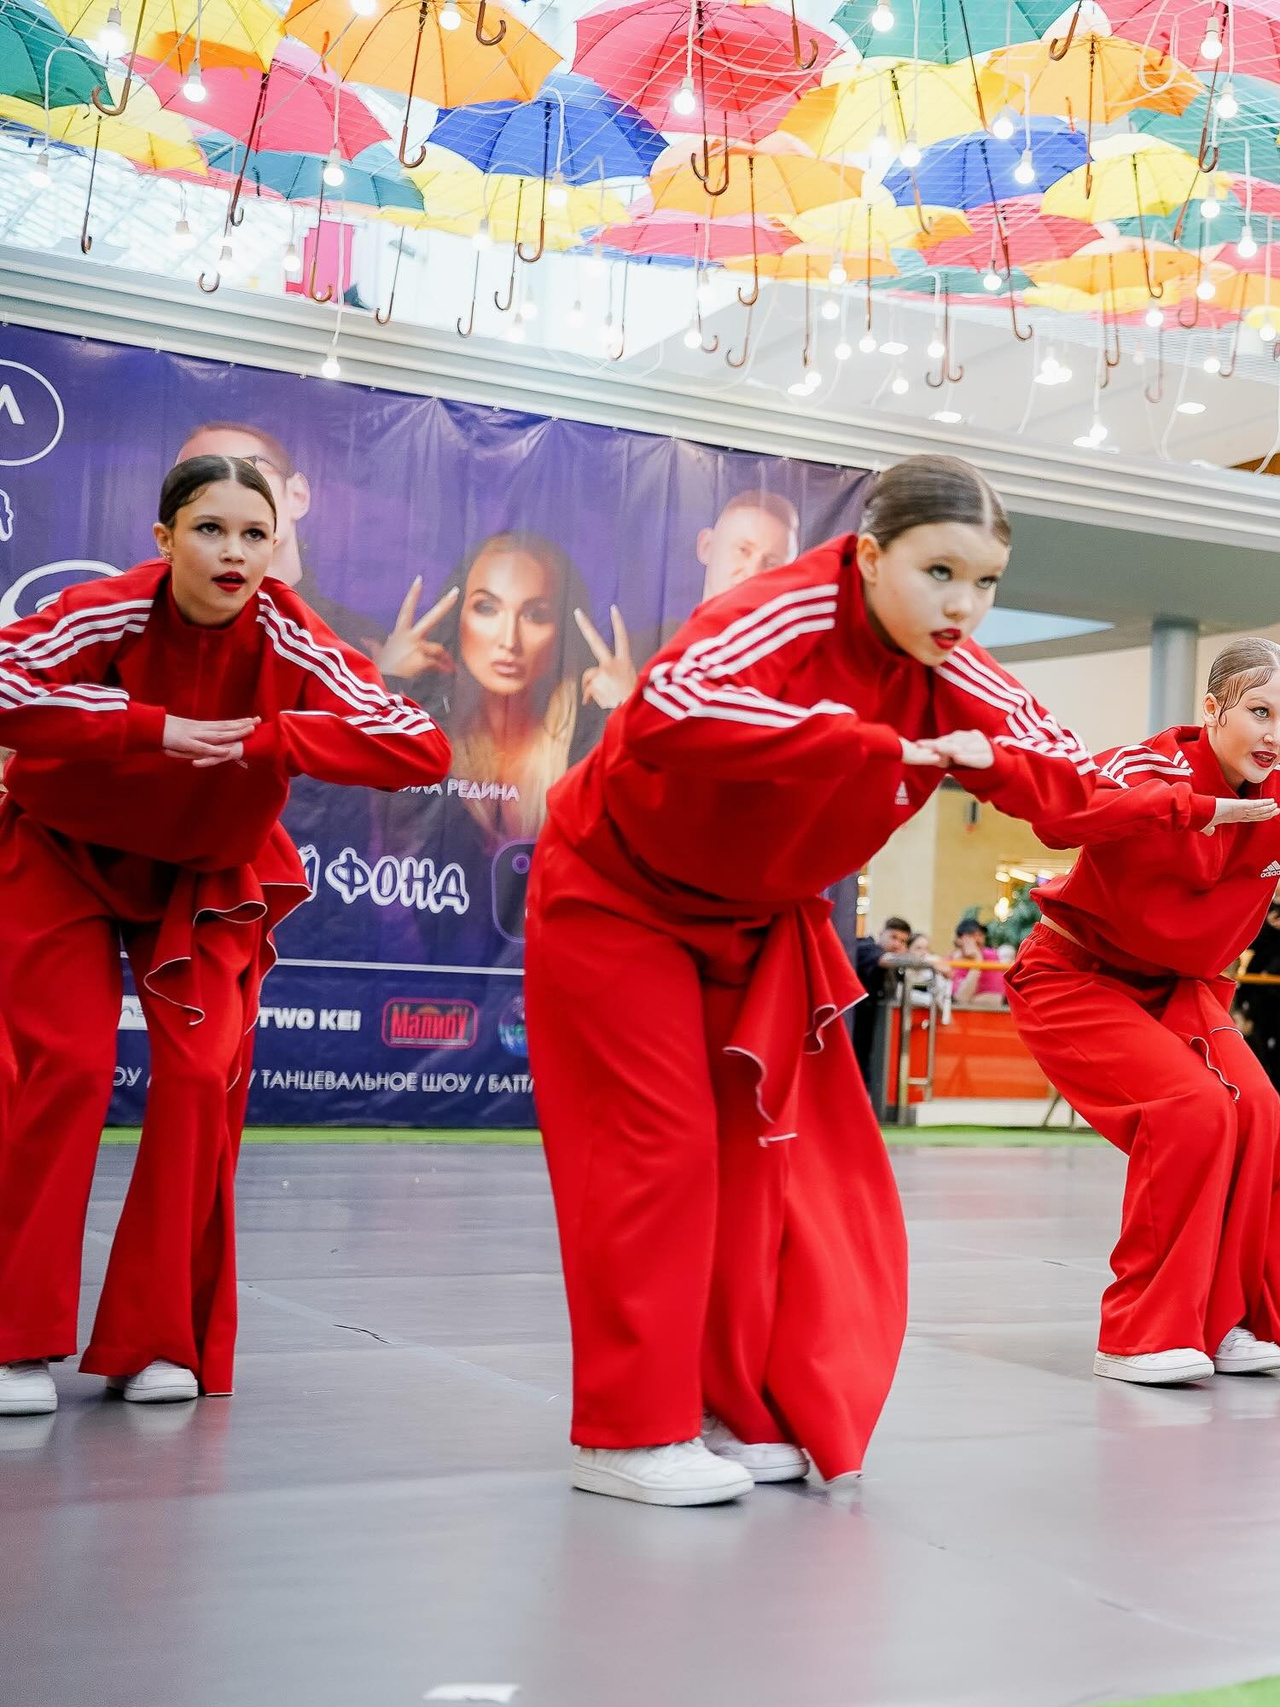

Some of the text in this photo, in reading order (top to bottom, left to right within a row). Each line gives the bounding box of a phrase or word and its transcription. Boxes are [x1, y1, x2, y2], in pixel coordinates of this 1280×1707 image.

[447, 778, 520, 801] РЕДИНА
[325, 847, 470, 915] ФОНД
[259, 1006, 361, 1031] TWO KEI
[113, 1065, 143, 1087] ОУ
[261, 1069, 418, 1092] ТАНЦЕВАЛЬНОЕ
[421, 1071, 472, 1093] ШОУ
